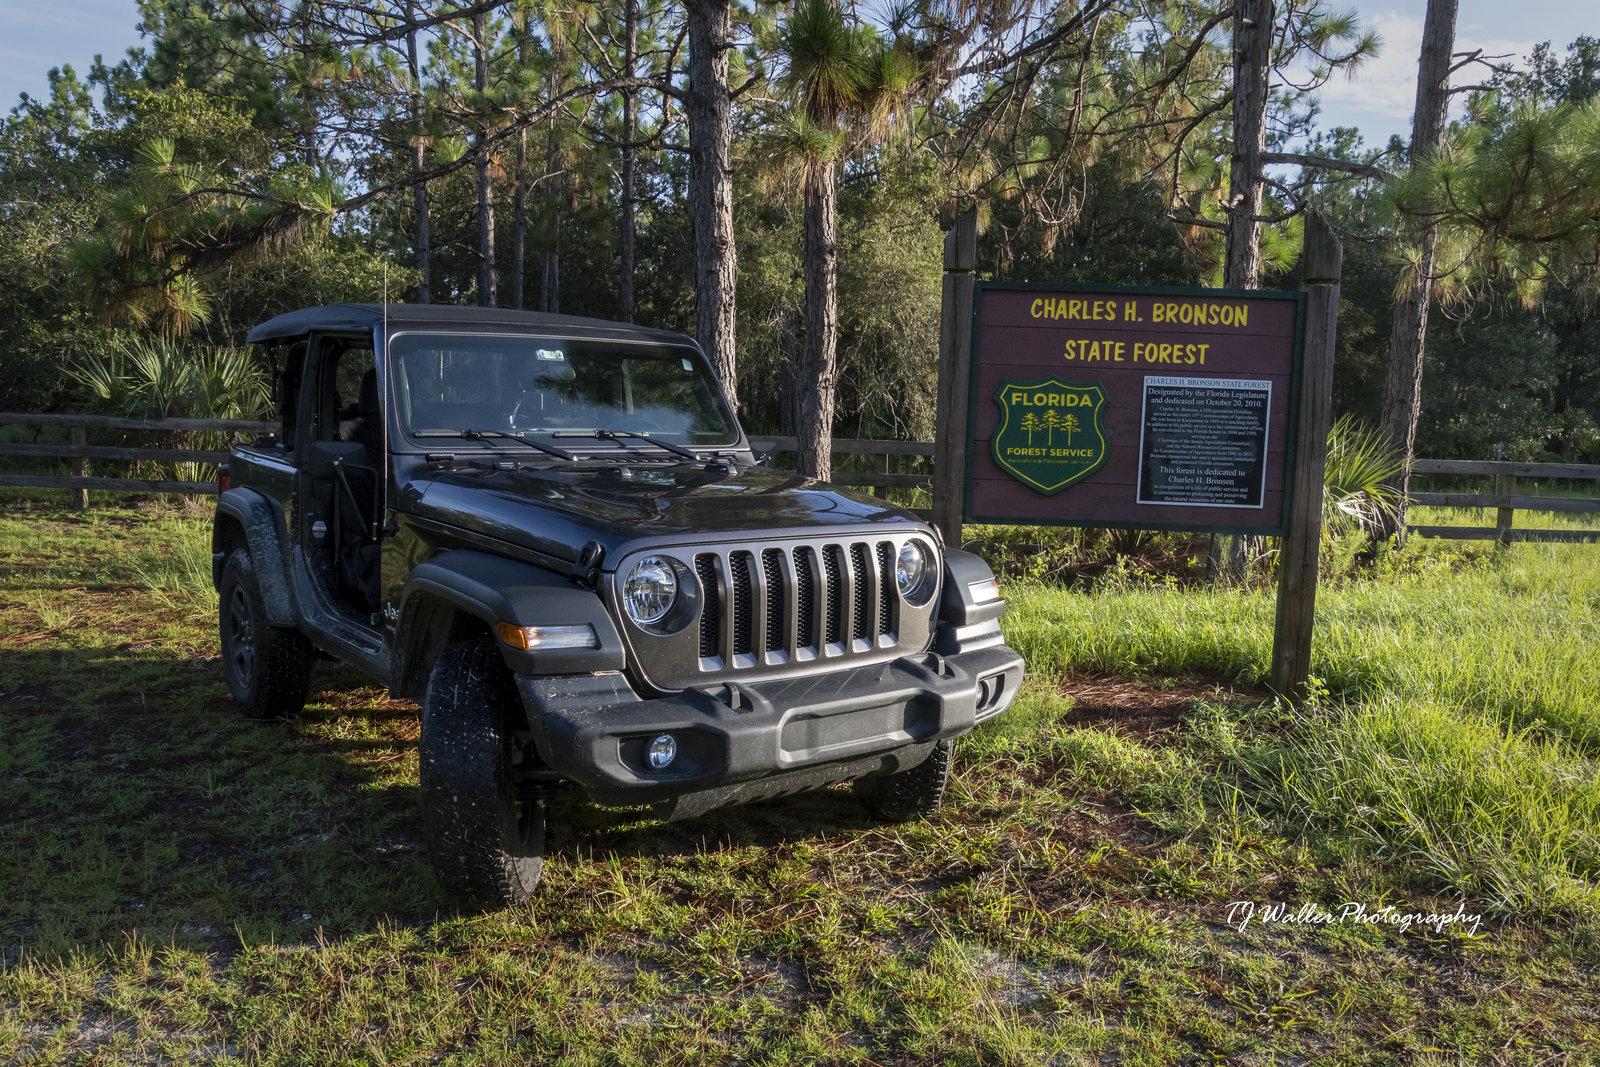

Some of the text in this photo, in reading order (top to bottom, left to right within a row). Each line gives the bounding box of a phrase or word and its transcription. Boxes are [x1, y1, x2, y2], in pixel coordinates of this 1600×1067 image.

[1030, 298, 1248, 328] CHARLES H. BRONSON
[1064, 339, 1210, 365] STATE FOREST
[1011, 392, 1093, 407] FLORIDA
[1149, 388, 1183, 397] Designated
[1207, 390, 1229, 398] Florida
[1231, 391, 1267, 400] Legislature
[1007, 447, 1094, 457] FOREST SERVICE
